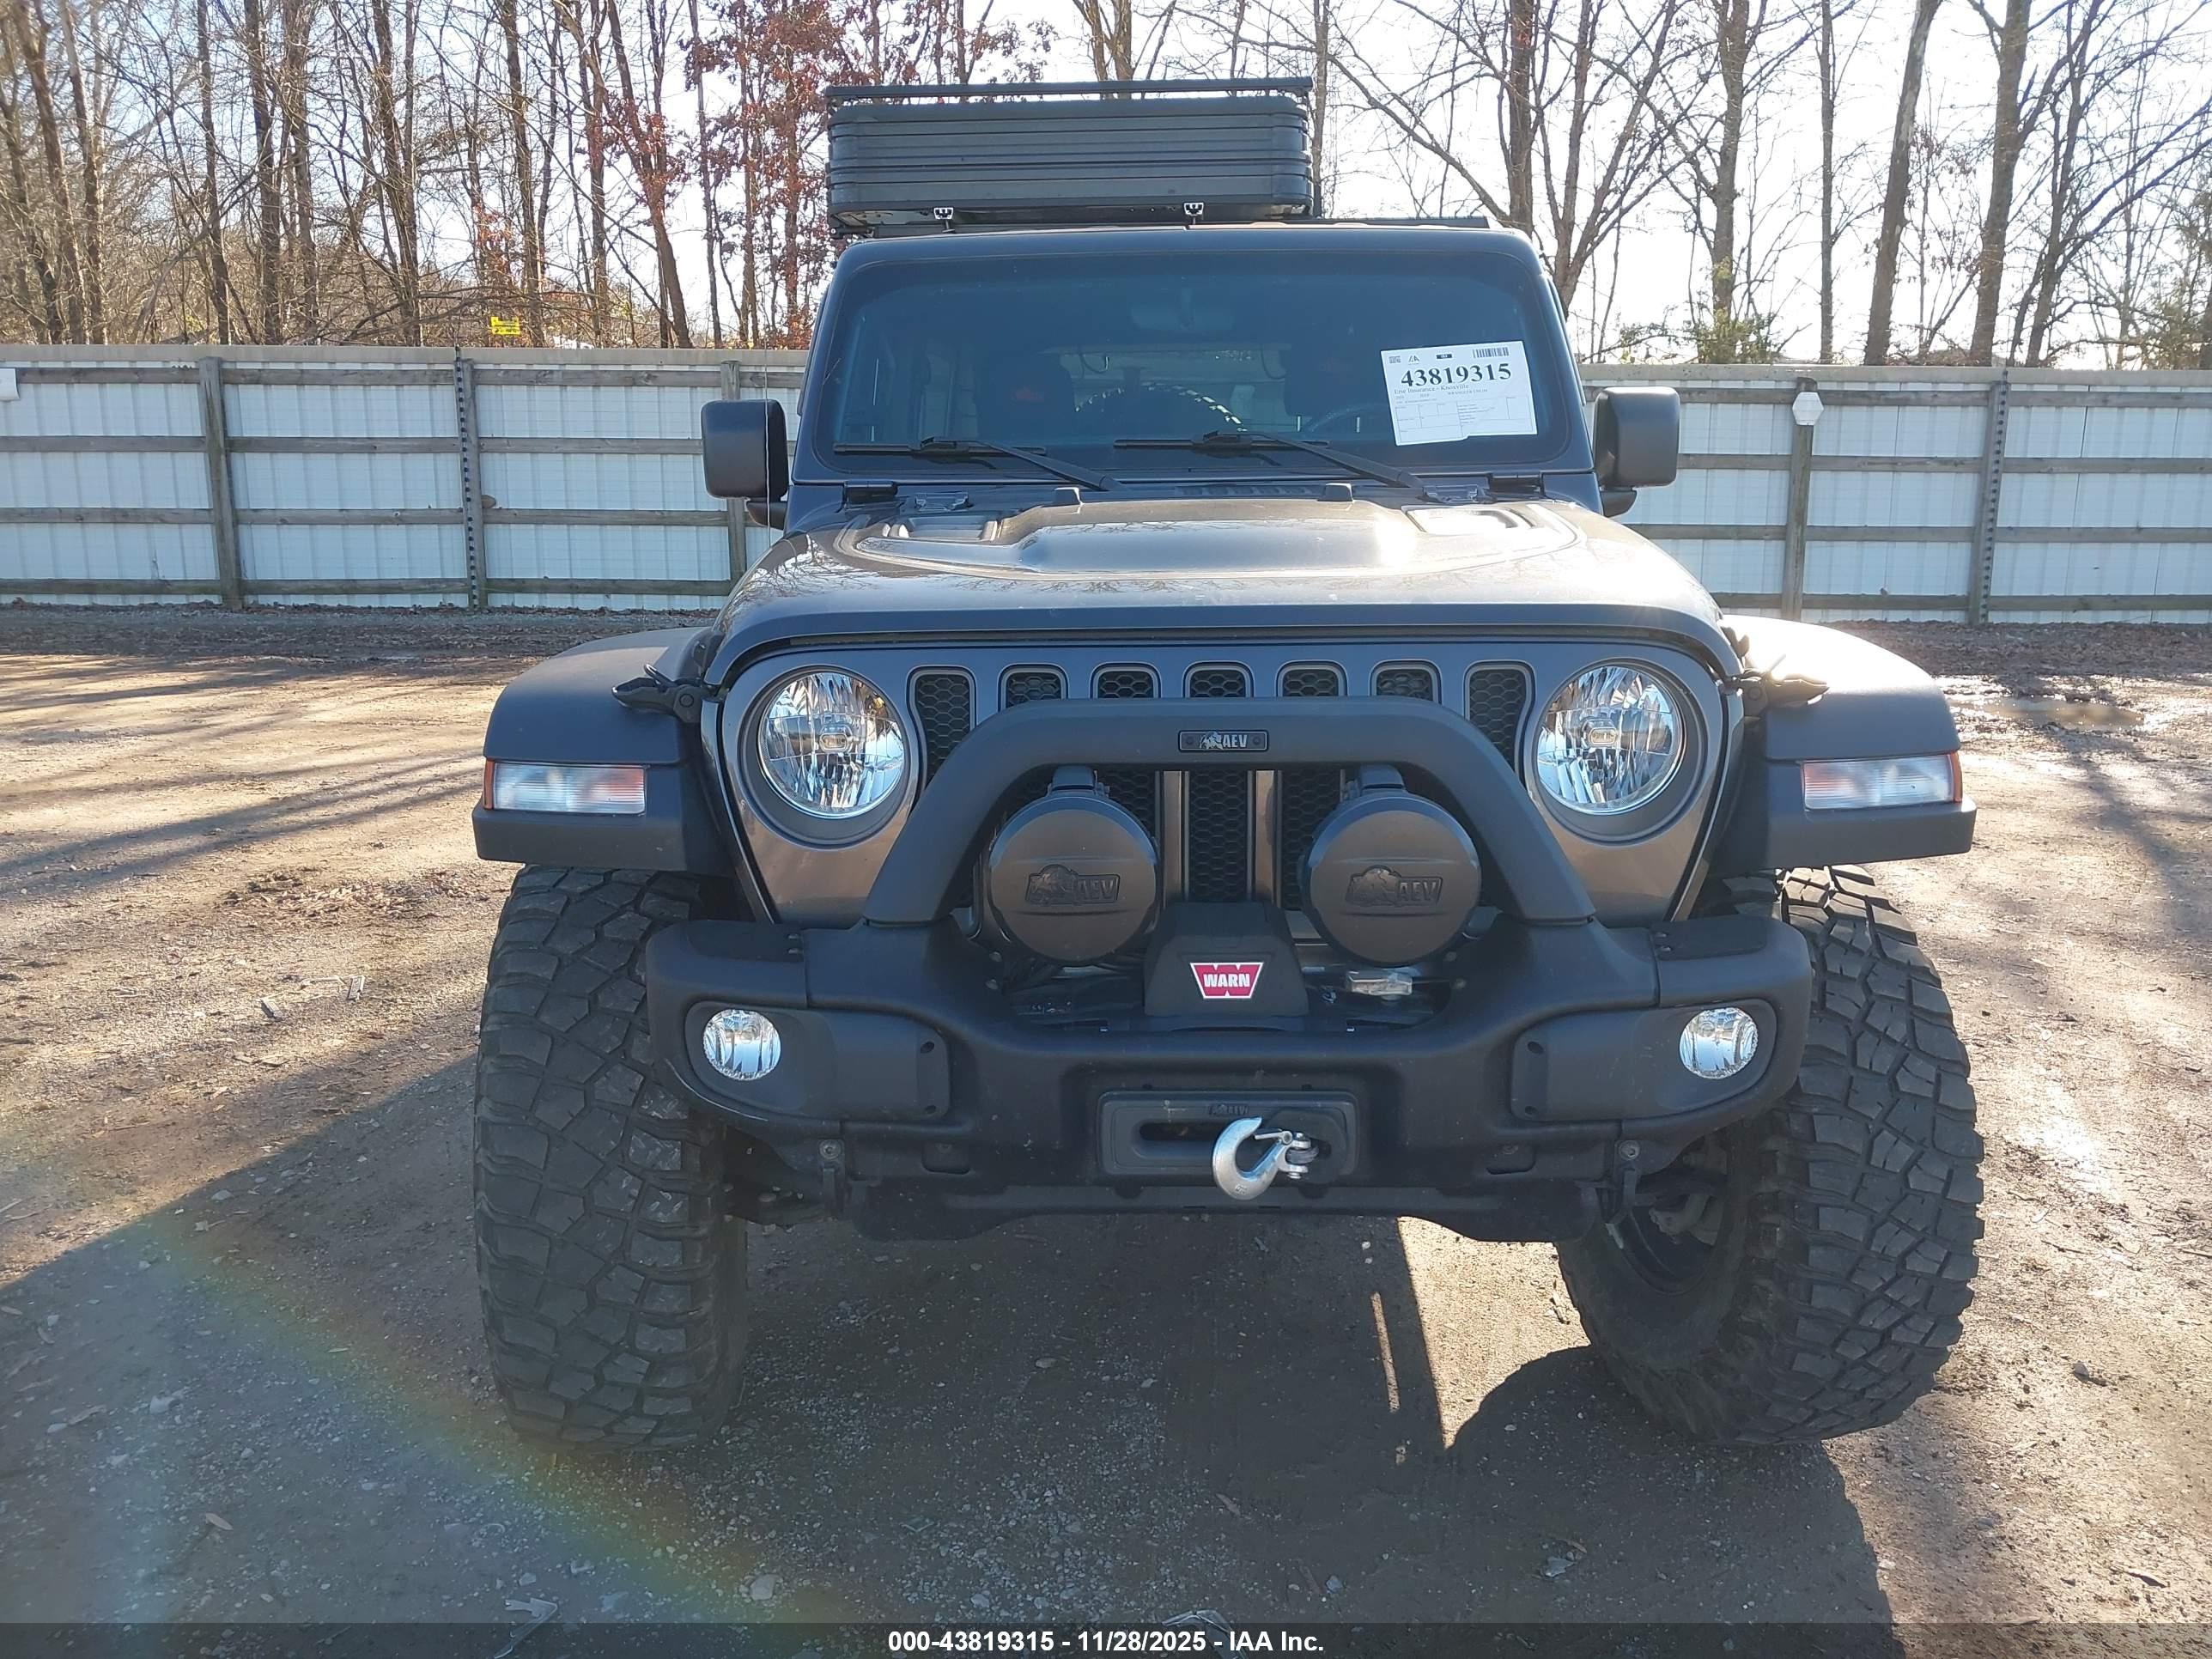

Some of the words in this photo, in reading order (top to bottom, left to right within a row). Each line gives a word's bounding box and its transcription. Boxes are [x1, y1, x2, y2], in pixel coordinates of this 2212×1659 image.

[1401, 363, 1511, 386] 43819315
[1223, 734, 1249, 748] AEV
[1078, 878, 1114, 900] AEV
[1399, 880, 1437, 902] AEV
[1202, 973, 1251, 988] WARN
